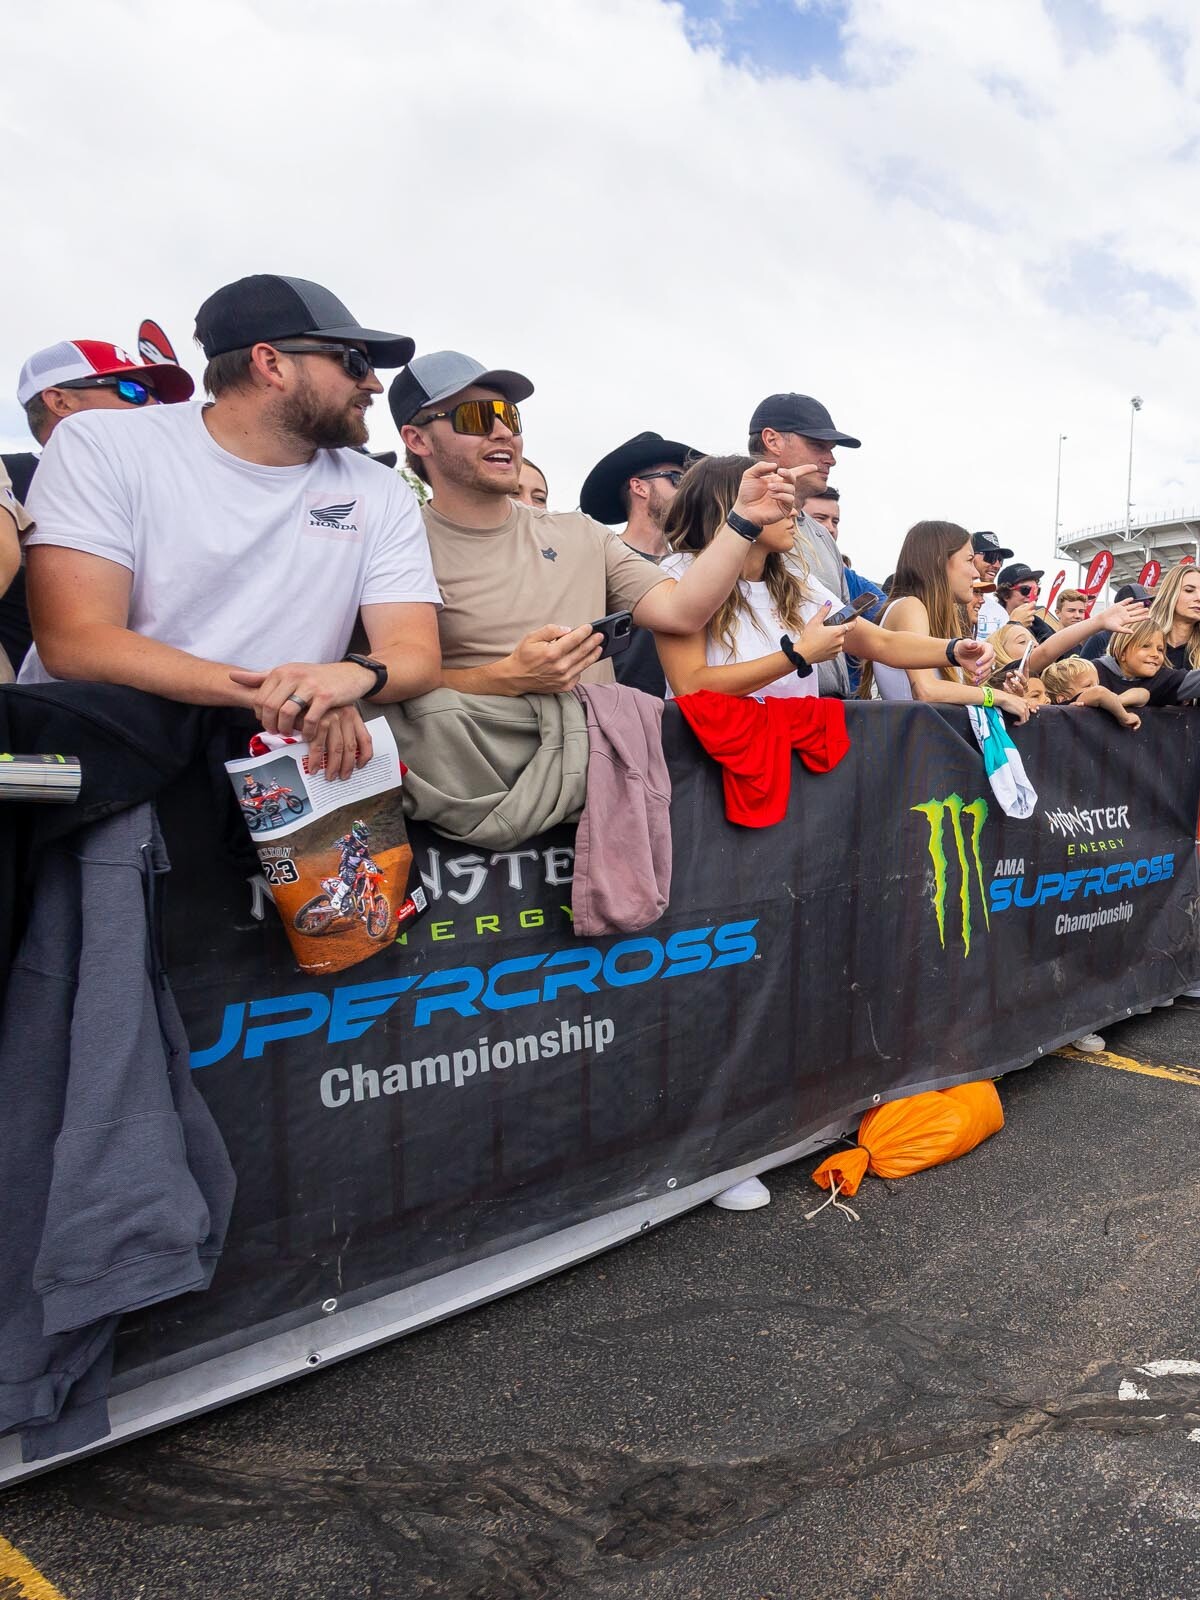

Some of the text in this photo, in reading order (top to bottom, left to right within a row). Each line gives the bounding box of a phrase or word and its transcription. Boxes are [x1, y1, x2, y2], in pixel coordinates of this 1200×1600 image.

[310, 520, 358, 531] HONDA
[1044, 805, 1131, 838] MONSTER
[1067, 838, 1125, 856] ENERGY
[261, 859, 300, 885] 23
[989, 853, 1175, 913] SUPERCROSS
[993, 858, 1025, 877] AMA
[1055, 901, 1133, 936] Championship
[189, 919, 761, 1069] UPERCROSS
[319, 1013, 617, 1109] Championship
